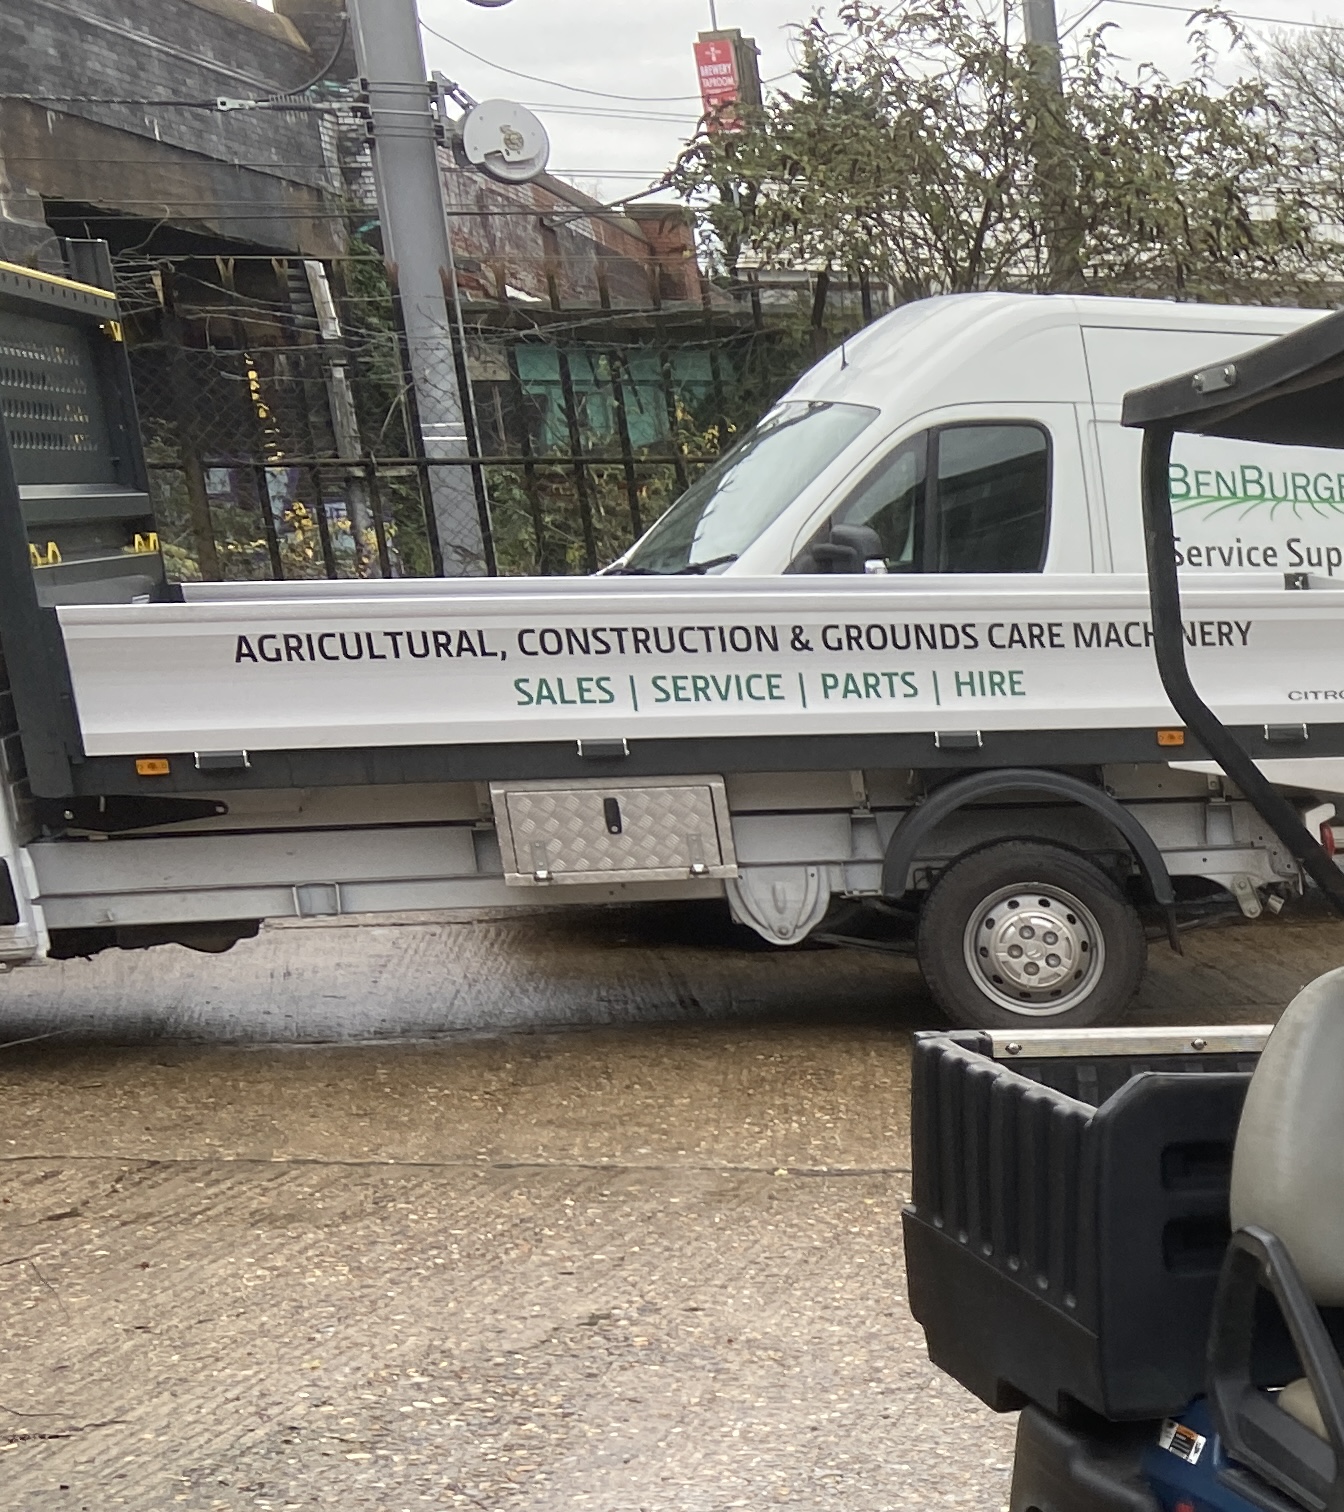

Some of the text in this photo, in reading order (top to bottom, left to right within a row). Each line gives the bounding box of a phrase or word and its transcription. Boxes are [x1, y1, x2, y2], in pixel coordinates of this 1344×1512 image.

[235, 621, 1253, 663] AGRICULTURAL, CONSTRUCTION & GROUNDS CARE MACNERY
[514, 670, 1027, 705] SALES SERVICE PARTS HIRE
